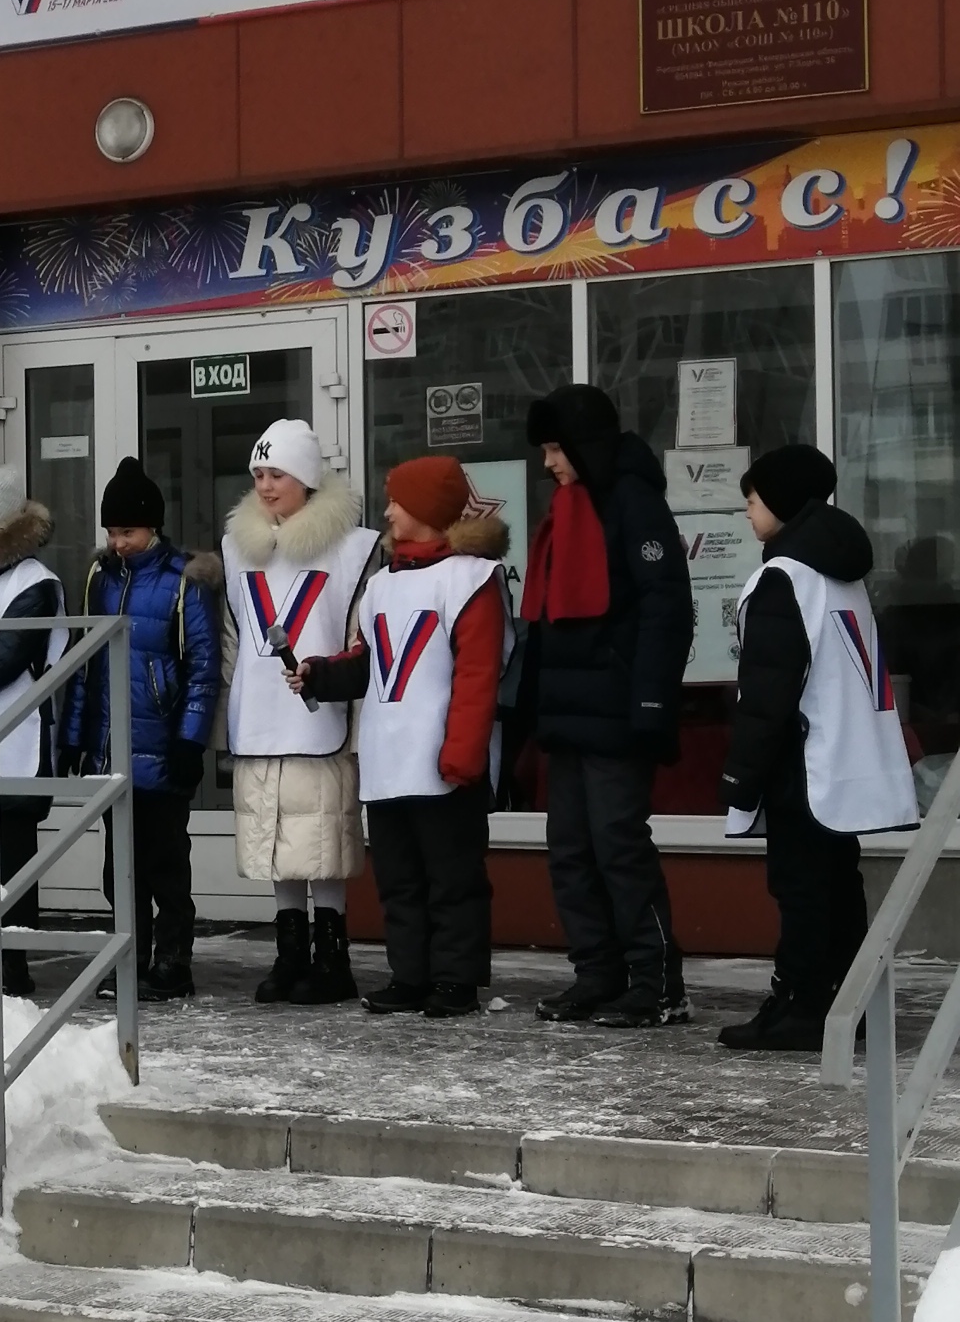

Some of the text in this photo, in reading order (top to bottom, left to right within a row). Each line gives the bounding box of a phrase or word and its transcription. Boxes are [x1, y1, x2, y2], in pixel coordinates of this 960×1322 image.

[657, 9, 764, 40] ШКОЛА
[228, 138, 922, 292] Кузбасс!
[195, 363, 246, 388] ВХОД
